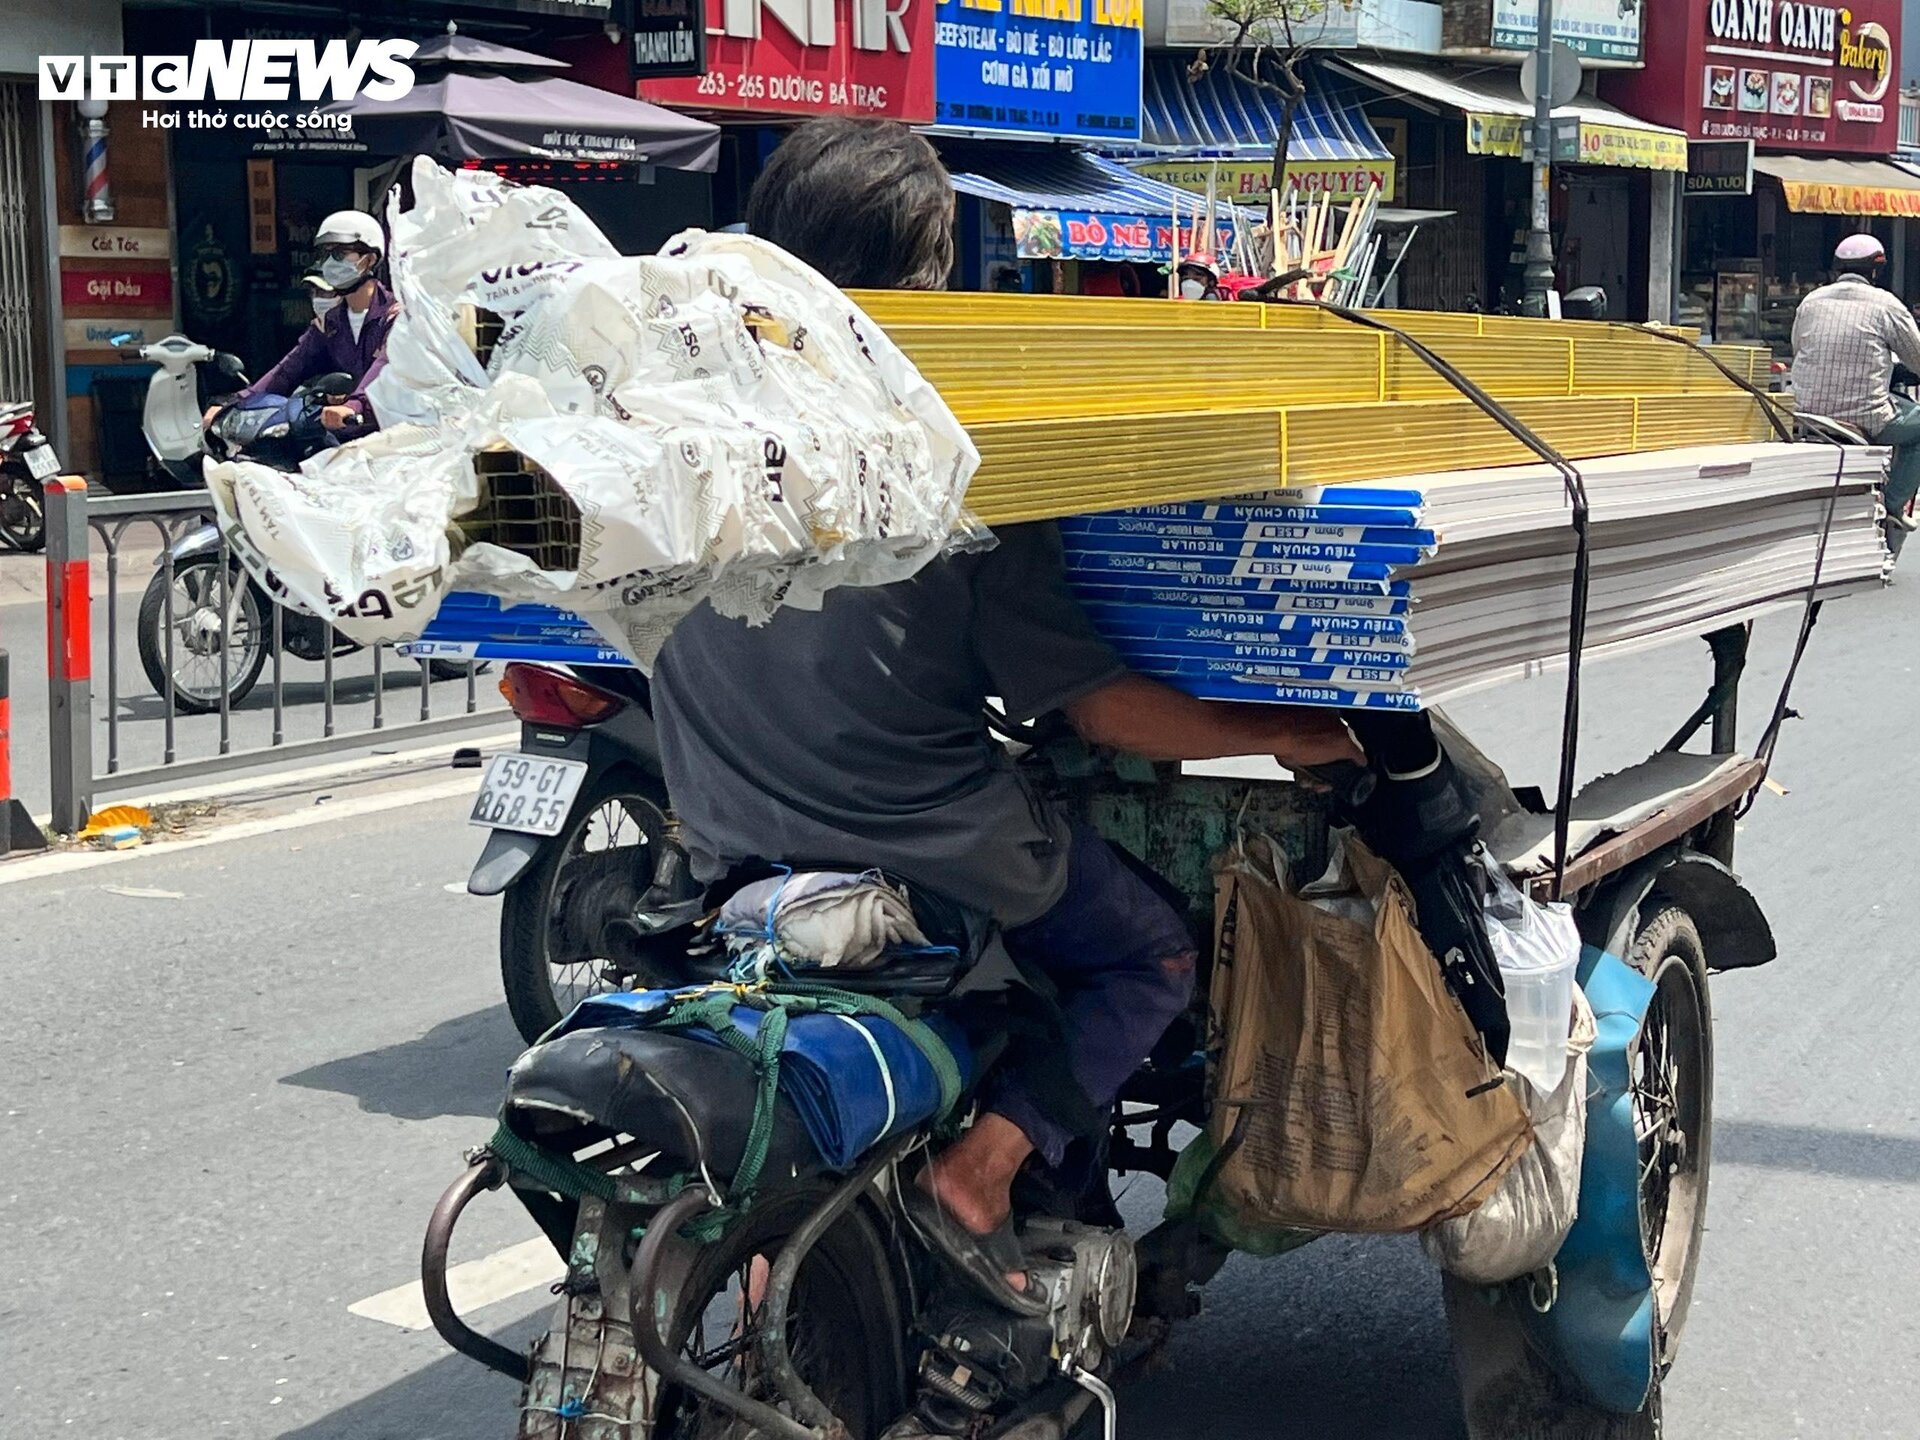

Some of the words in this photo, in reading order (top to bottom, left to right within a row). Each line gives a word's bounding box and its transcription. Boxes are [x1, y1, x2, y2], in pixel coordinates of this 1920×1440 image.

[1710, 0, 1773, 43] OANH
[1780, 2, 1836, 51] OANH
[1839, 28, 1889, 81] Bakery
[1012, 61, 1028, 89] GÀ
[698, 71, 725, 95] 263
[738, 74, 764, 98] 265
[830, 76, 848, 106] BÁ
[1314, 526, 1344, 538] 9mm
[1162, 539, 1224, 552] REGULAR
[1272, 545, 1320, 560] CHUẨN
[1302, 563, 1332, 574] 9mm
[1180, 573, 1243, 586] REGULAR
[1202, 611, 1264, 625] REGULAR
[1311, 616, 1360, 632] CHUẨN
[1235, 645, 1297, 657] REGULAR
[1344, 650, 1391, 666] CHUẨN
[1276, 687, 1338, 701] REGULAR
